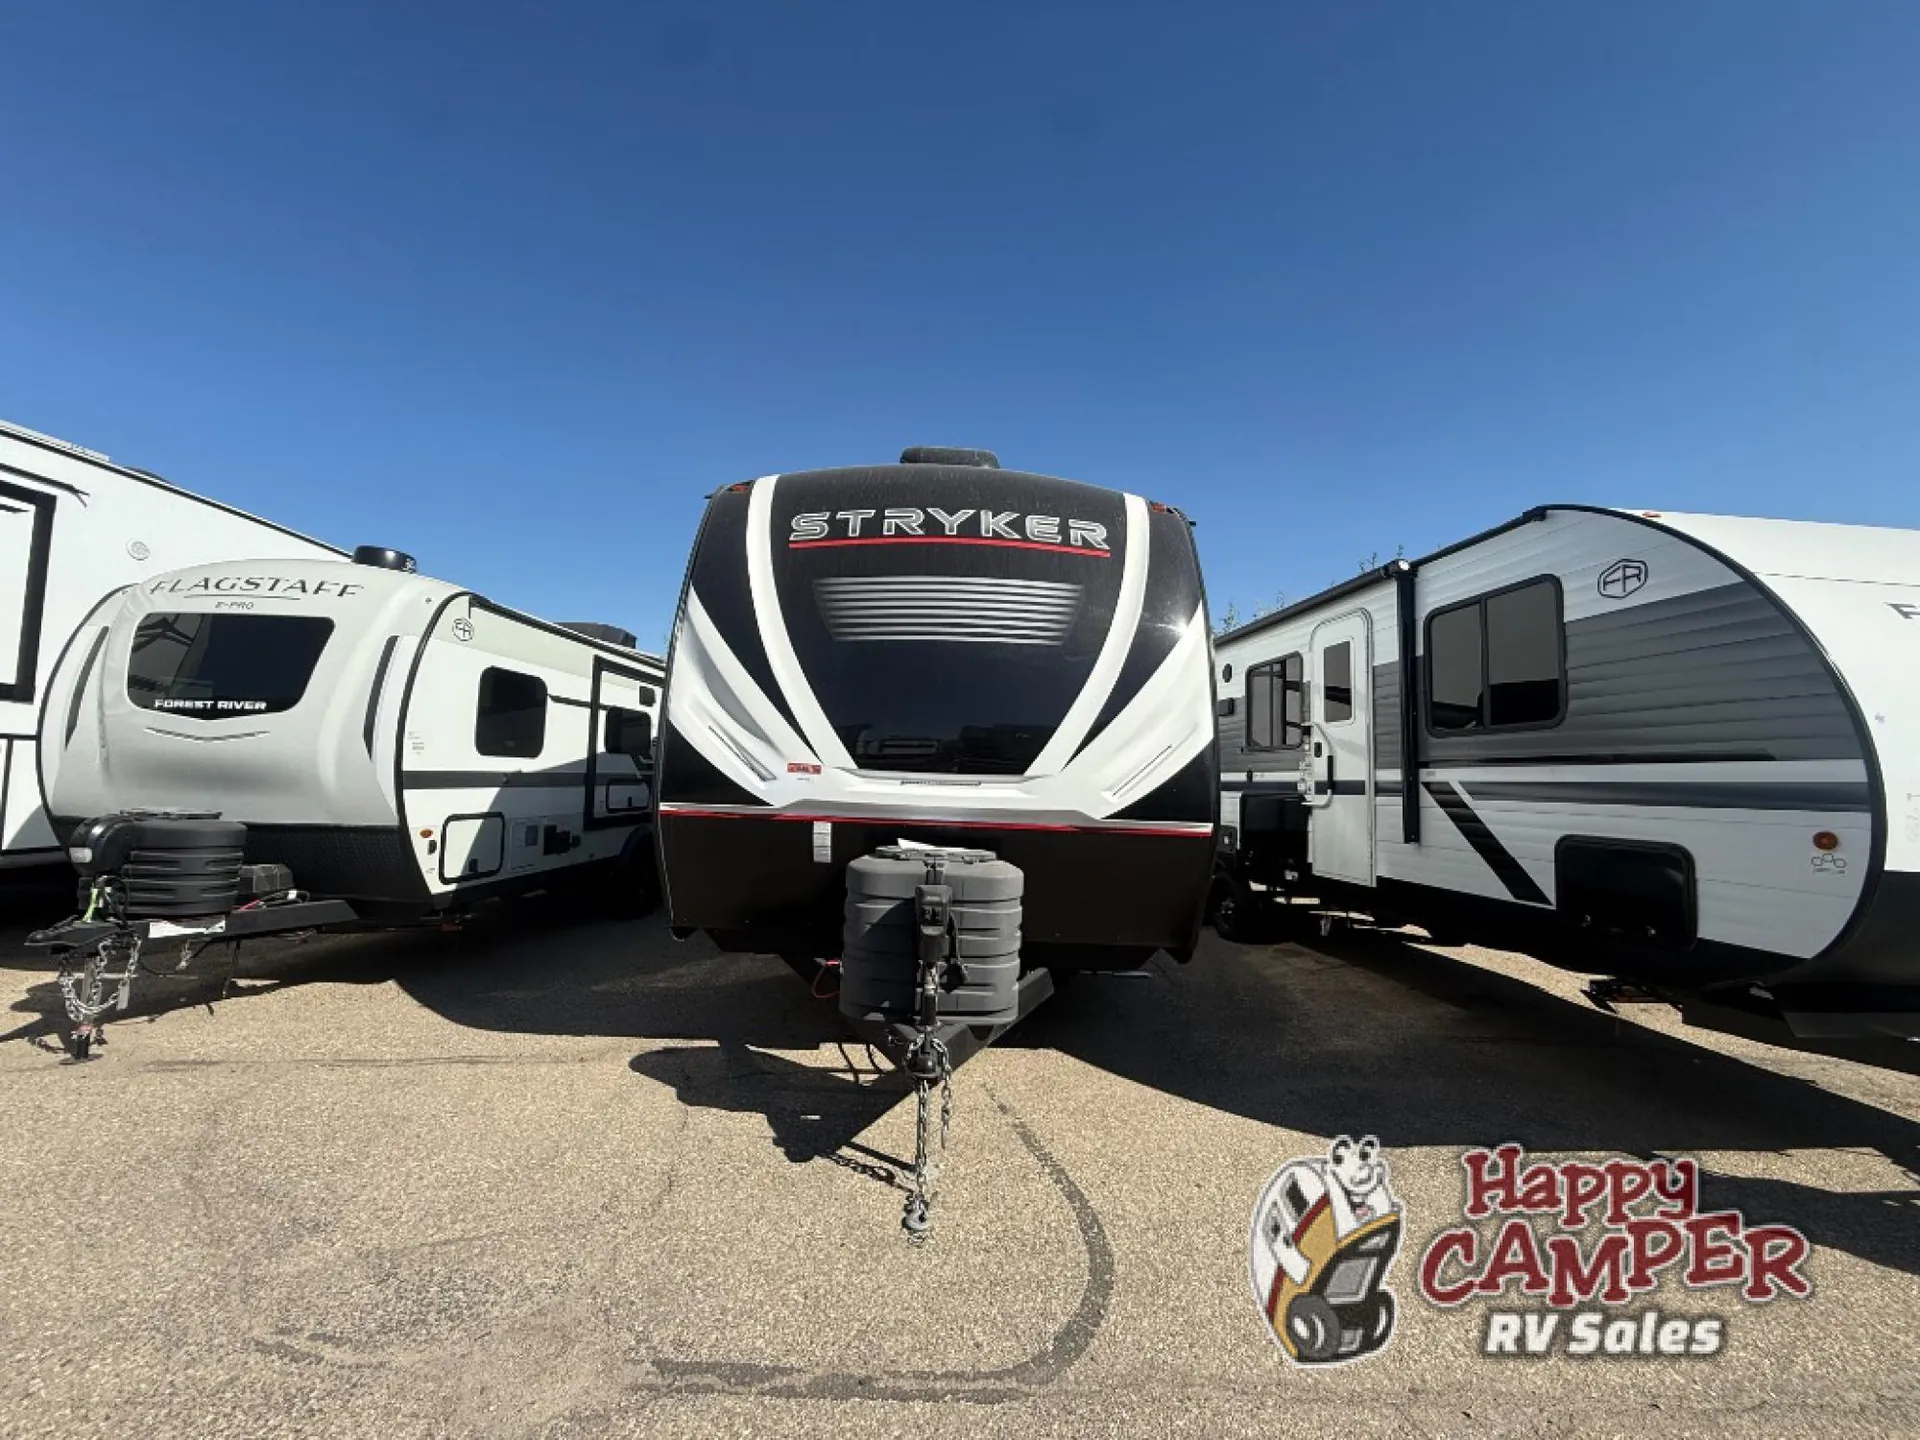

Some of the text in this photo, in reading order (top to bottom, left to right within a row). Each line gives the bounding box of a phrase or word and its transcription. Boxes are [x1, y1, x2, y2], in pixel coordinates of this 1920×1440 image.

[789, 507, 1110, 550] STRYKER
[150, 576, 365, 597] FLAGSTAFF
[214, 600, 255, 610] E-PRO
[154, 699, 267, 710] FOREST RIVER
